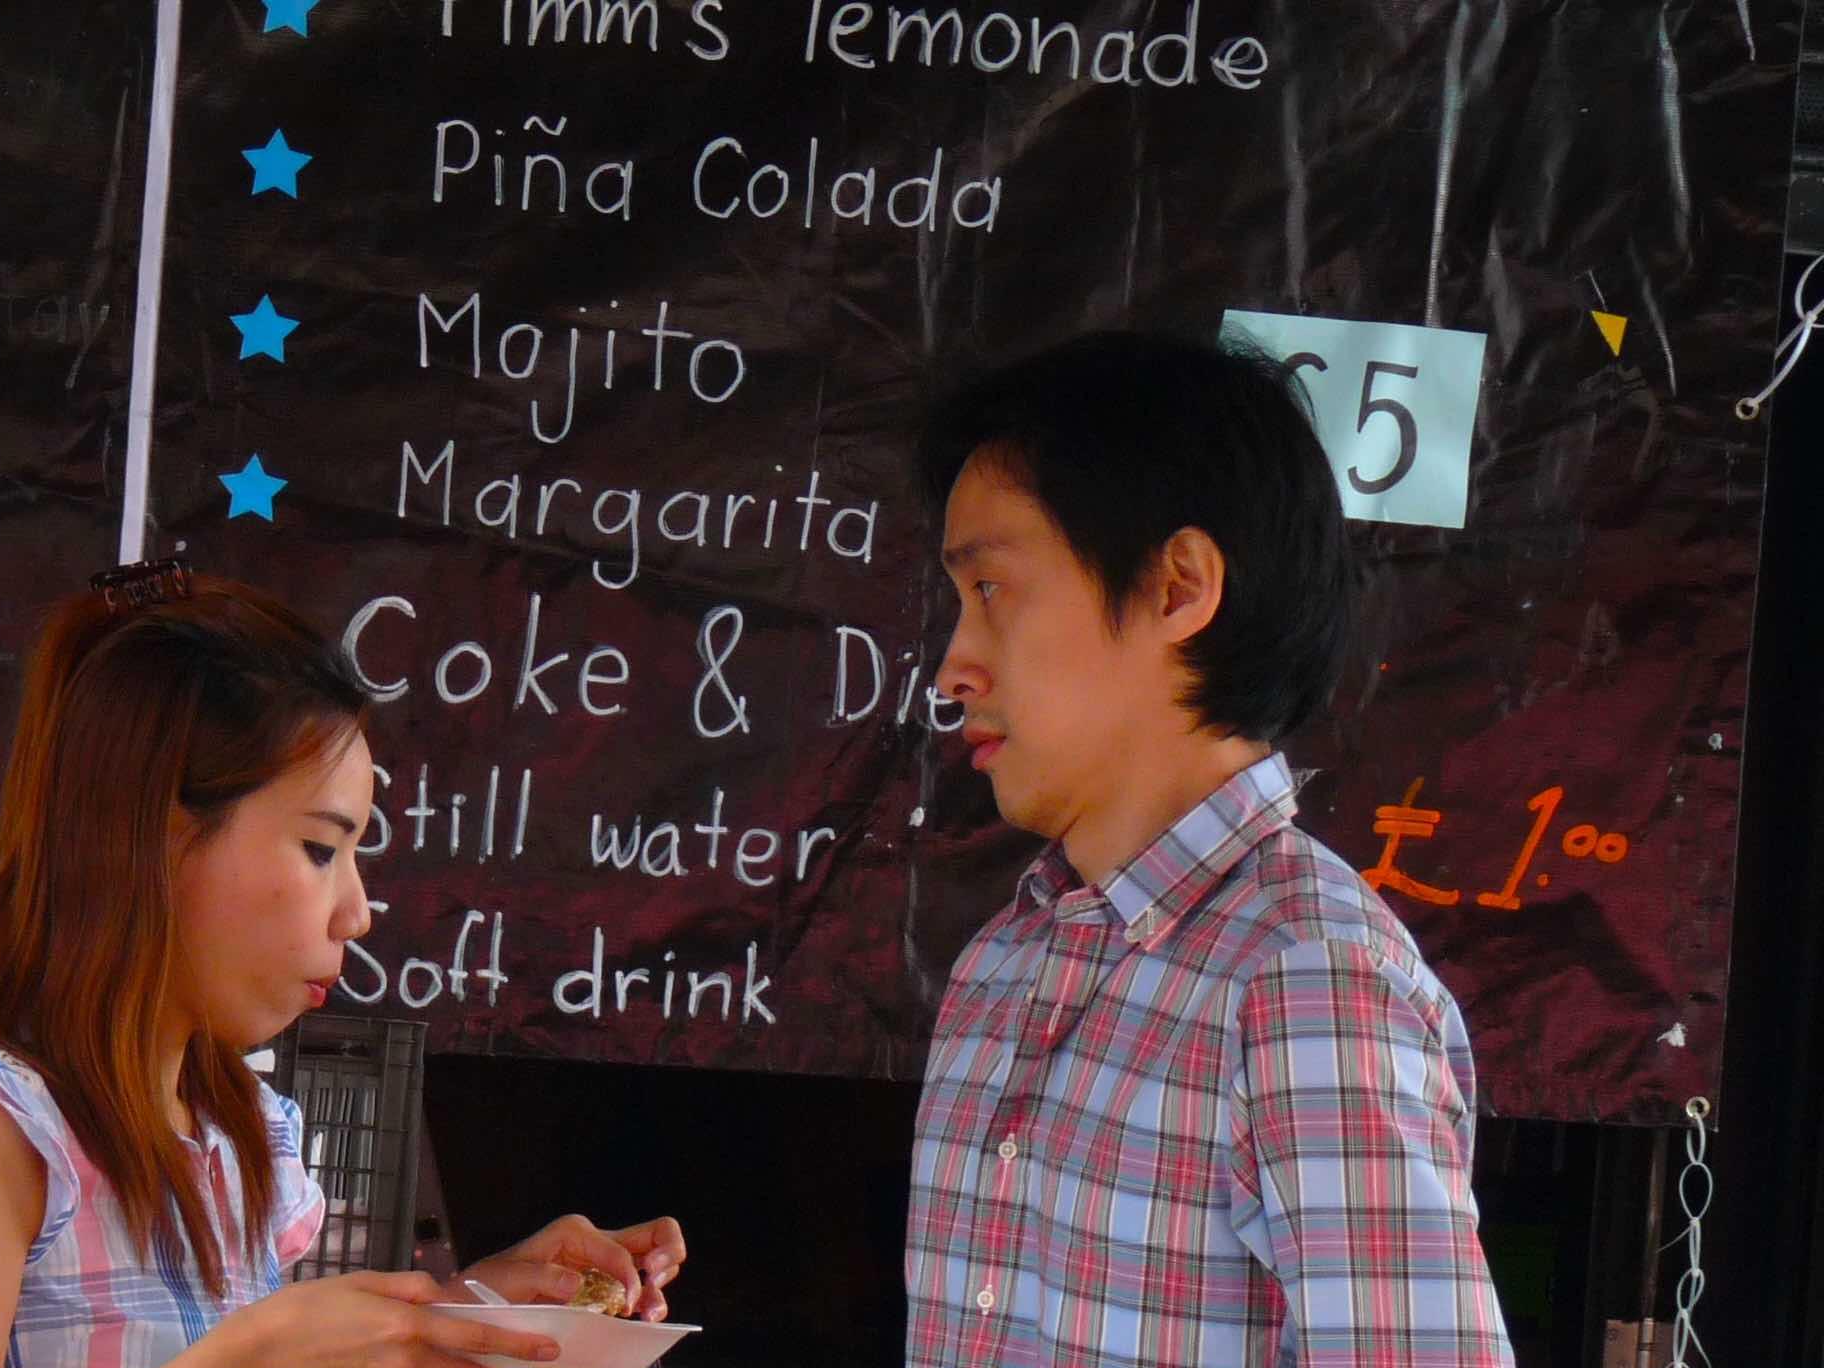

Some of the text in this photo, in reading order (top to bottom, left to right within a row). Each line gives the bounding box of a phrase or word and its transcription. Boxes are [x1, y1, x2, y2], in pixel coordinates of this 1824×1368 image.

[805, 0, 1270, 89] lemonade
[433, 115, 1002, 233] Piña Colada
[418, 292, 747, 444] Mojito
[398, 439, 879, 590] Margarita
[341, 593, 631, 715] Coke
[693, 606, 750, 738] &
[356, 763, 835, 887] Still water
[338, 900, 777, 1025] Soft drink
